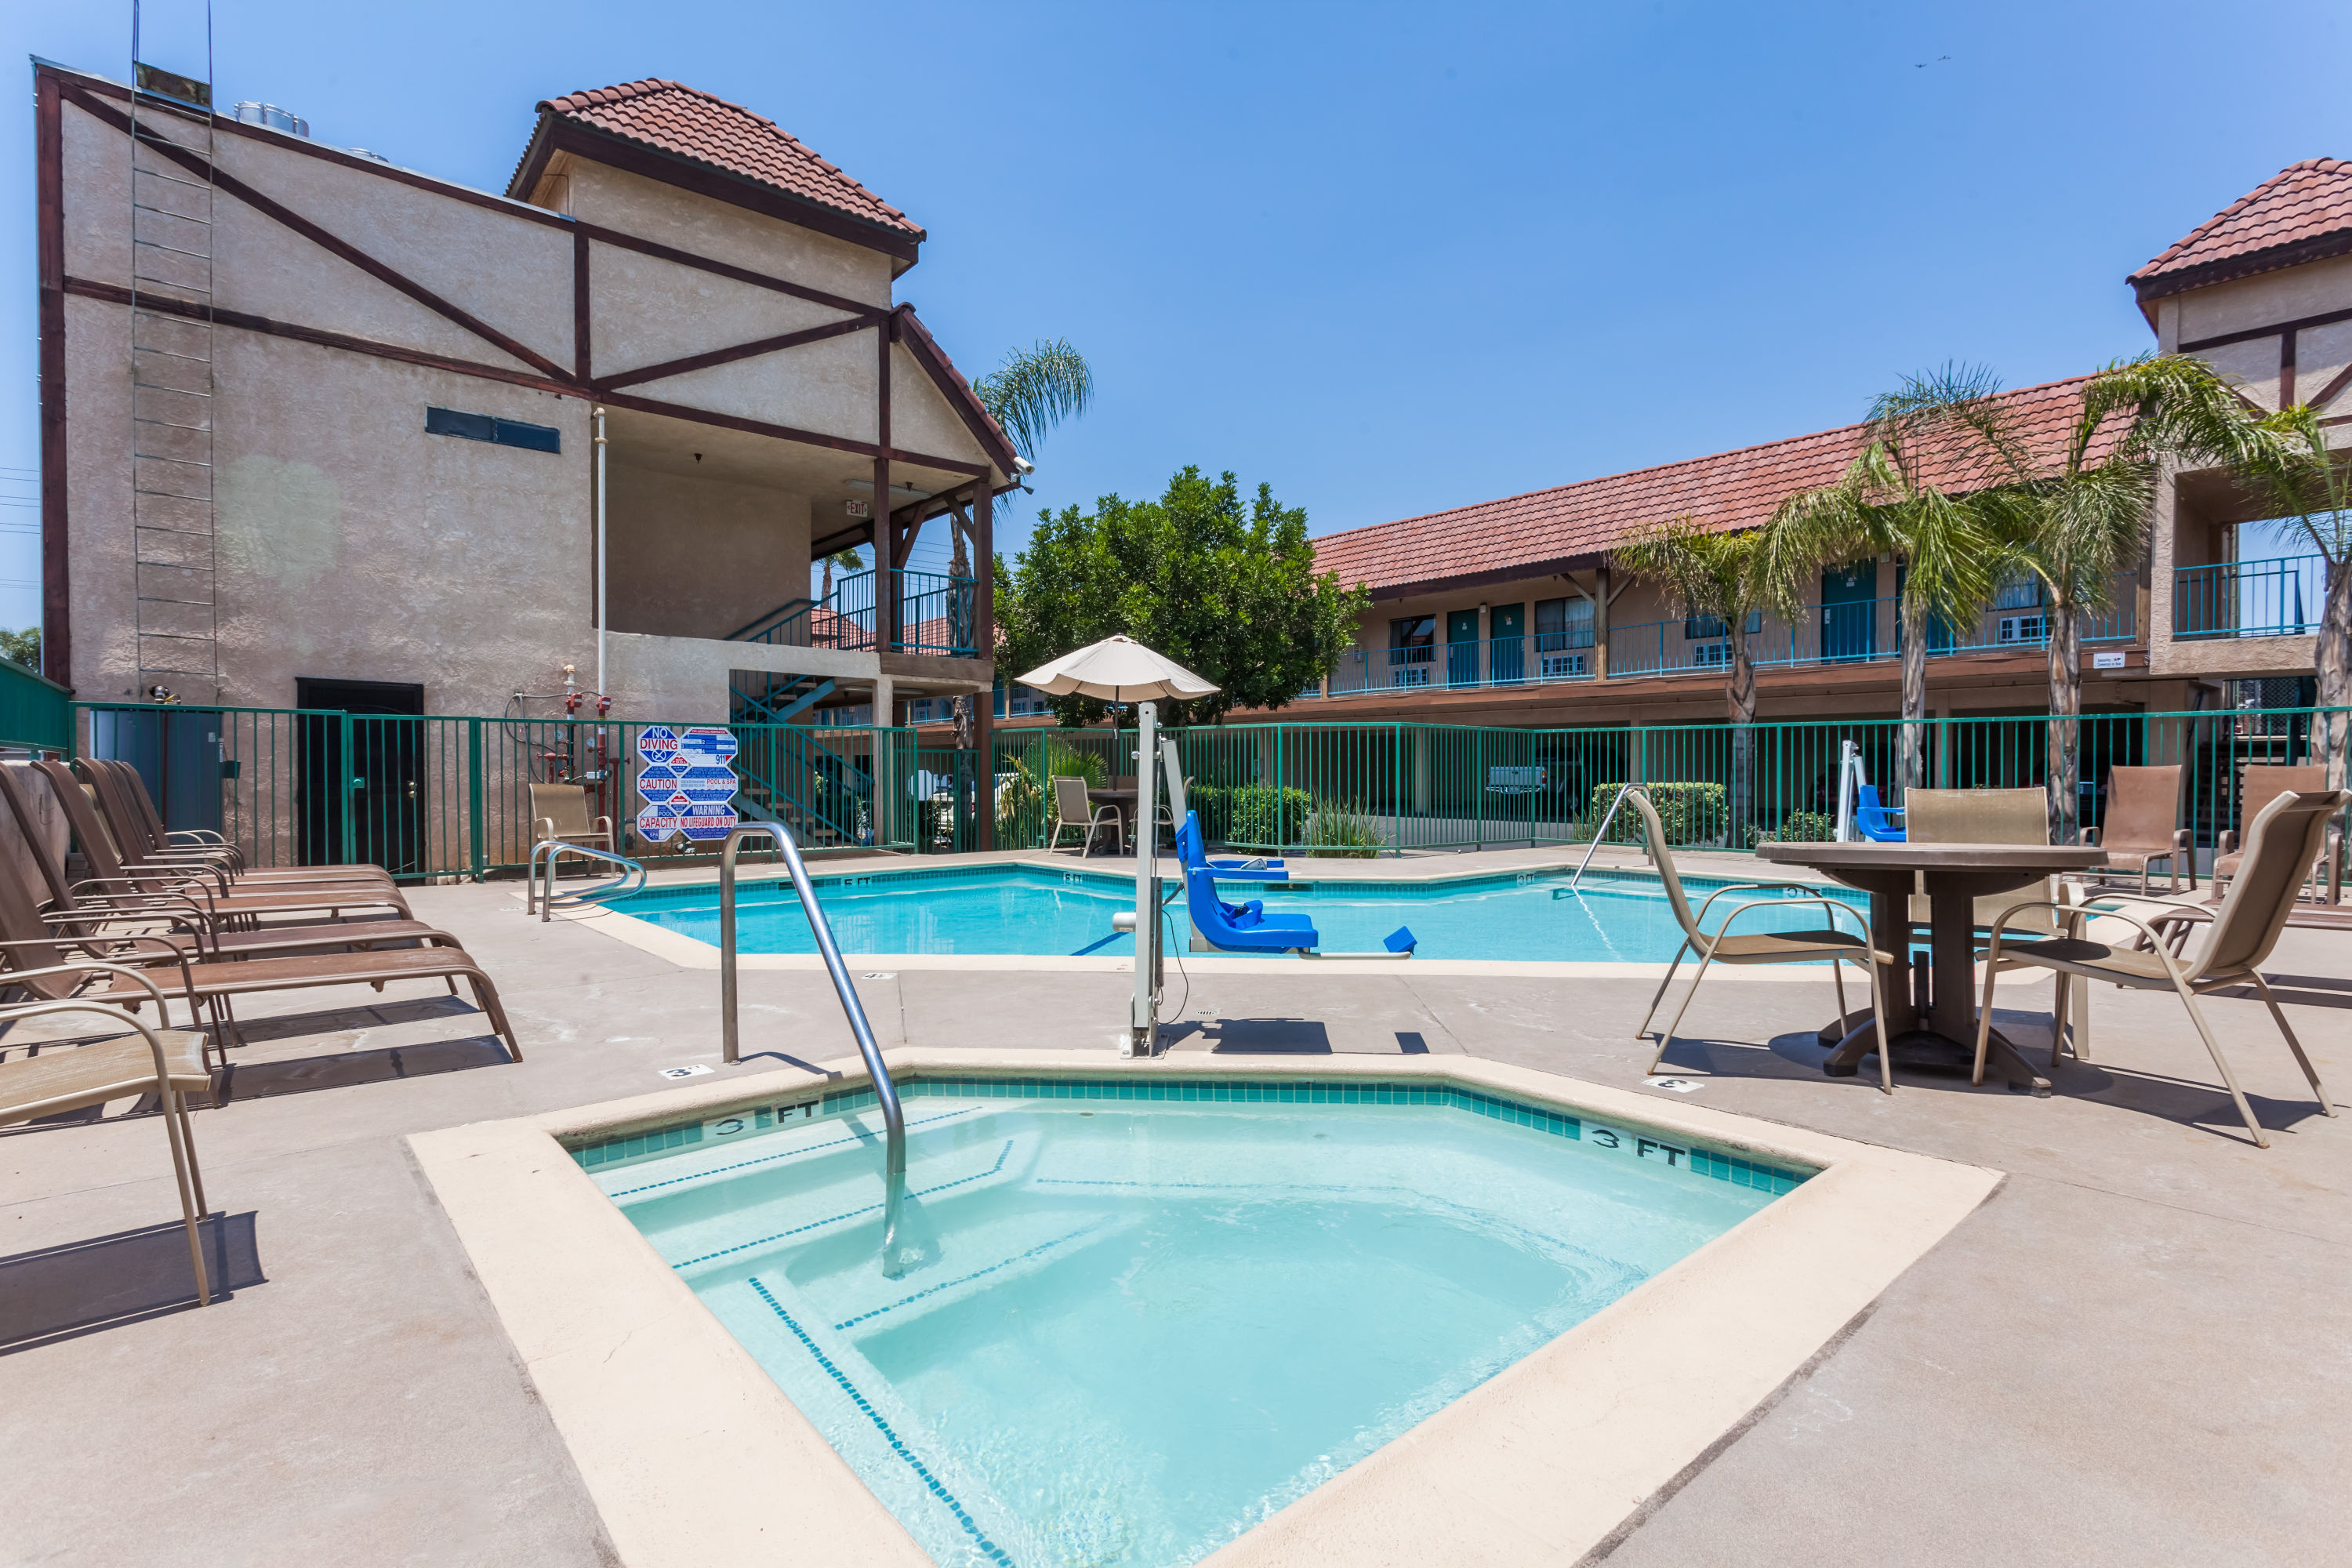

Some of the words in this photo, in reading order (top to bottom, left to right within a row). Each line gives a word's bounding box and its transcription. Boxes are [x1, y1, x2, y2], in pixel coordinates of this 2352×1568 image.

[851, 502, 865, 515] EXIT
[652, 728, 667, 739] NO
[640, 739, 677, 750] DIVING
[716, 755, 726, 764] 911
[640, 779, 677, 789] CAUTION
[692, 805, 725, 815] WARNING
[640, 818, 677, 828] CAPACITY
[681, 818, 688, 827] NO
[689, 817, 714, 827] LIFEGUARD
[716, 817, 722, 826] ON
[724, 817, 736, 826] DUTY
[716, 1119, 744, 1135] 3
[778, 1100, 819, 1123] FT
[1592, 1130, 1620, 1148] 3
[1637, 1138, 1686, 1167] FT
